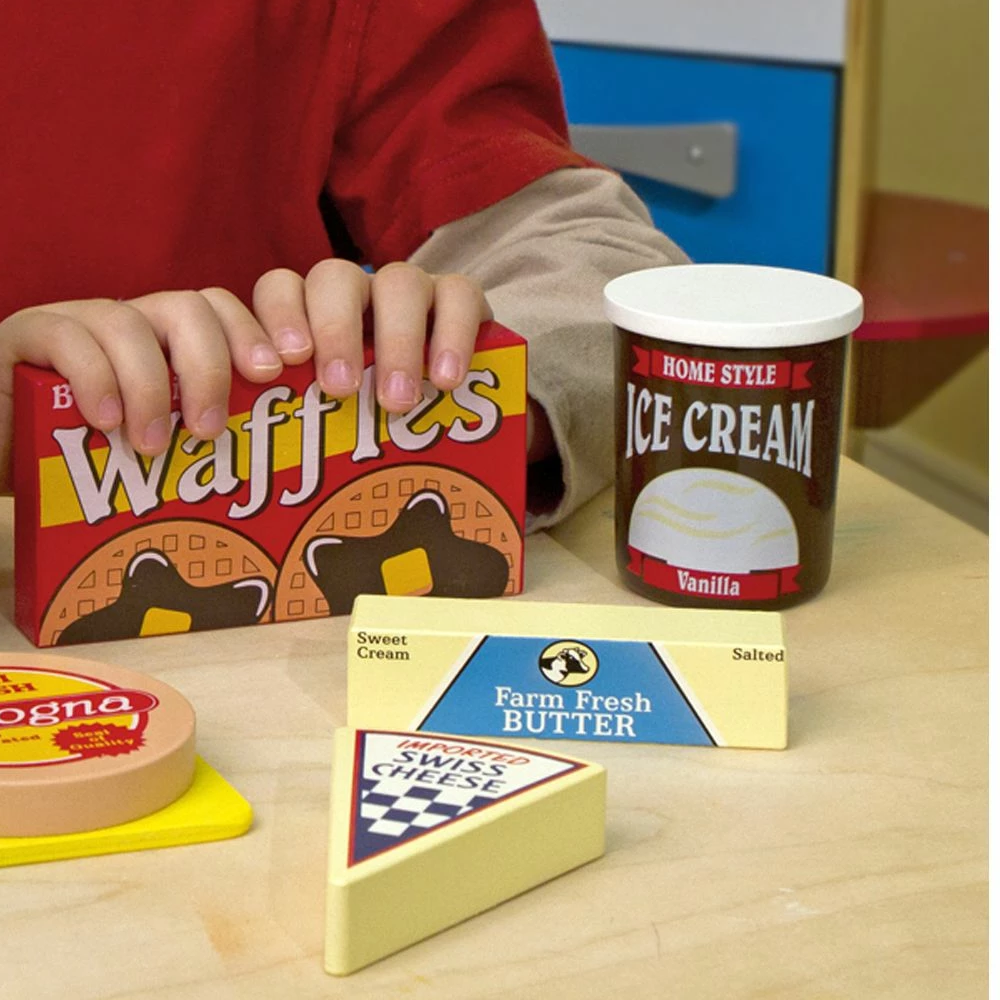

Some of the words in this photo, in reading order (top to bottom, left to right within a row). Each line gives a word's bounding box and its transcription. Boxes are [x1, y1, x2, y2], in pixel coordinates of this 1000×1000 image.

[663, 354, 715, 383] HOME
[720, 363, 776, 386] STYLE
[626, 382, 673, 460] ICE
[682, 399, 816, 479] CREAM
[52, 365, 501, 524] Waffles
[677, 568, 741, 597] Vanilla
[357, 632, 408, 646] Sweet
[357, 646, 410, 661] Cream
[732, 648, 785, 662] Salted
[494, 686, 565, 708] Farm
[575, 690, 652, 713] Fresh
[502, 709, 637, 738] BUTTER
[69, 738, 135, 751] Quality
[396, 739, 531, 766] IMPORTED
[393, 750, 508, 777] SWISS
[371, 763, 507, 794] CHEESE
